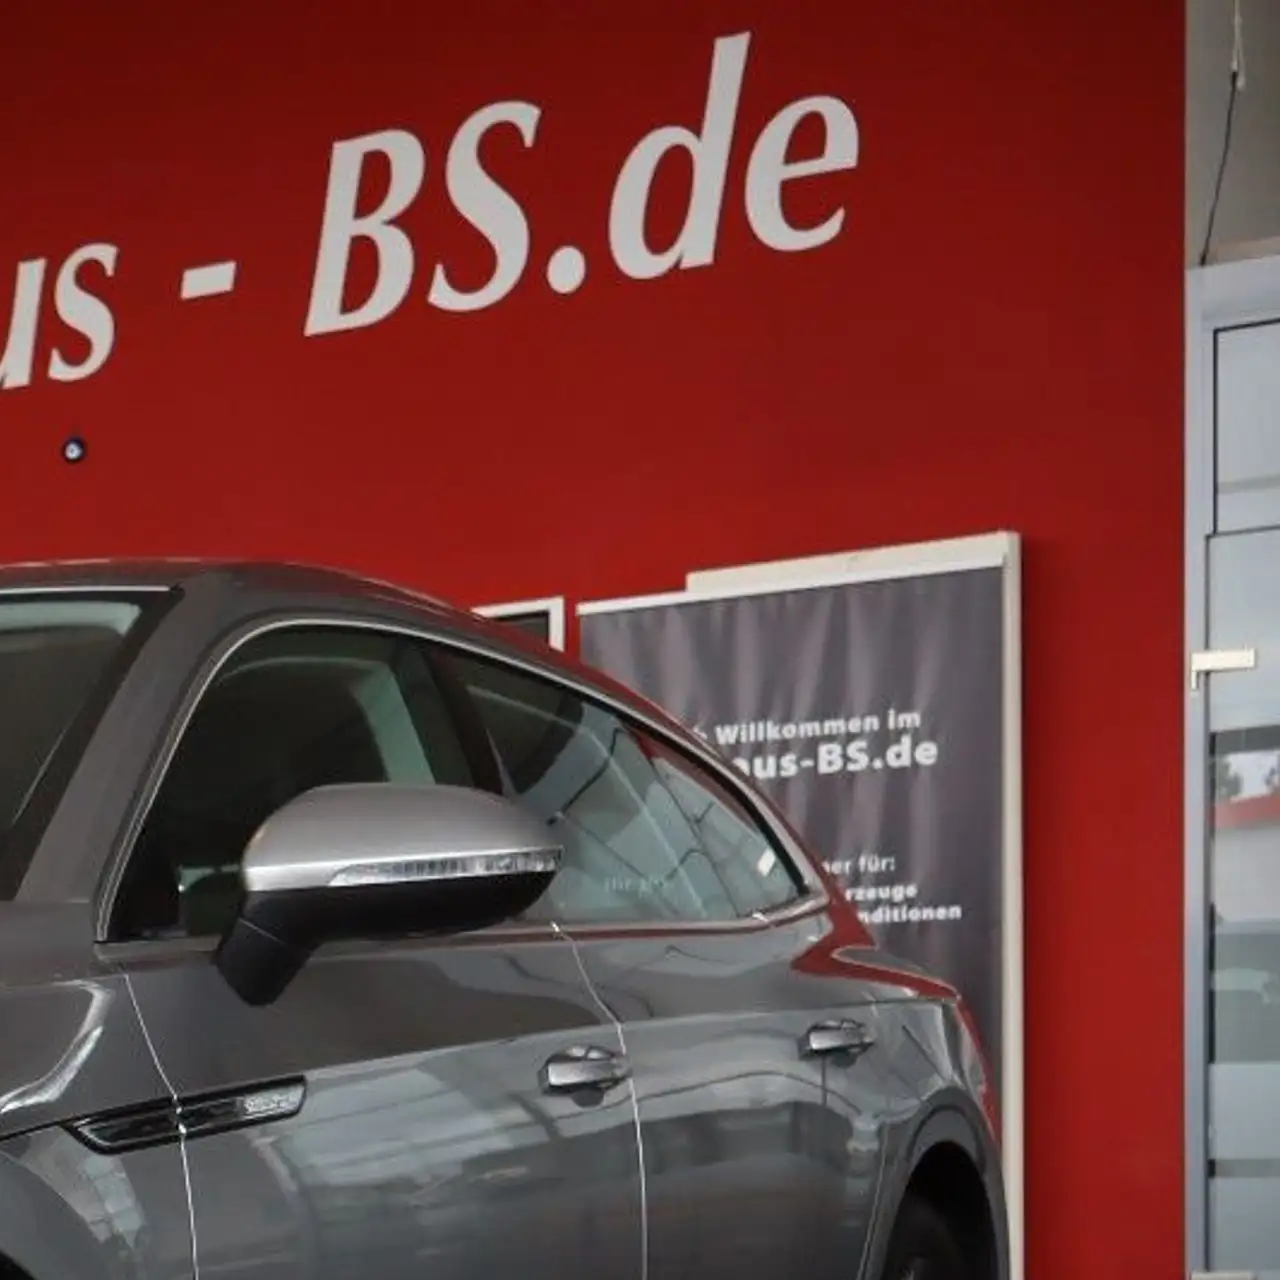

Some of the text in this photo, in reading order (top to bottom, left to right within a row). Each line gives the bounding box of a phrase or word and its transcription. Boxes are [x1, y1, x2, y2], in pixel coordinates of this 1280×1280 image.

[304, 31, 859, 337] BS.de
[715, 714, 880, 745] Willkommen
[887, 709, 921, 730] im
